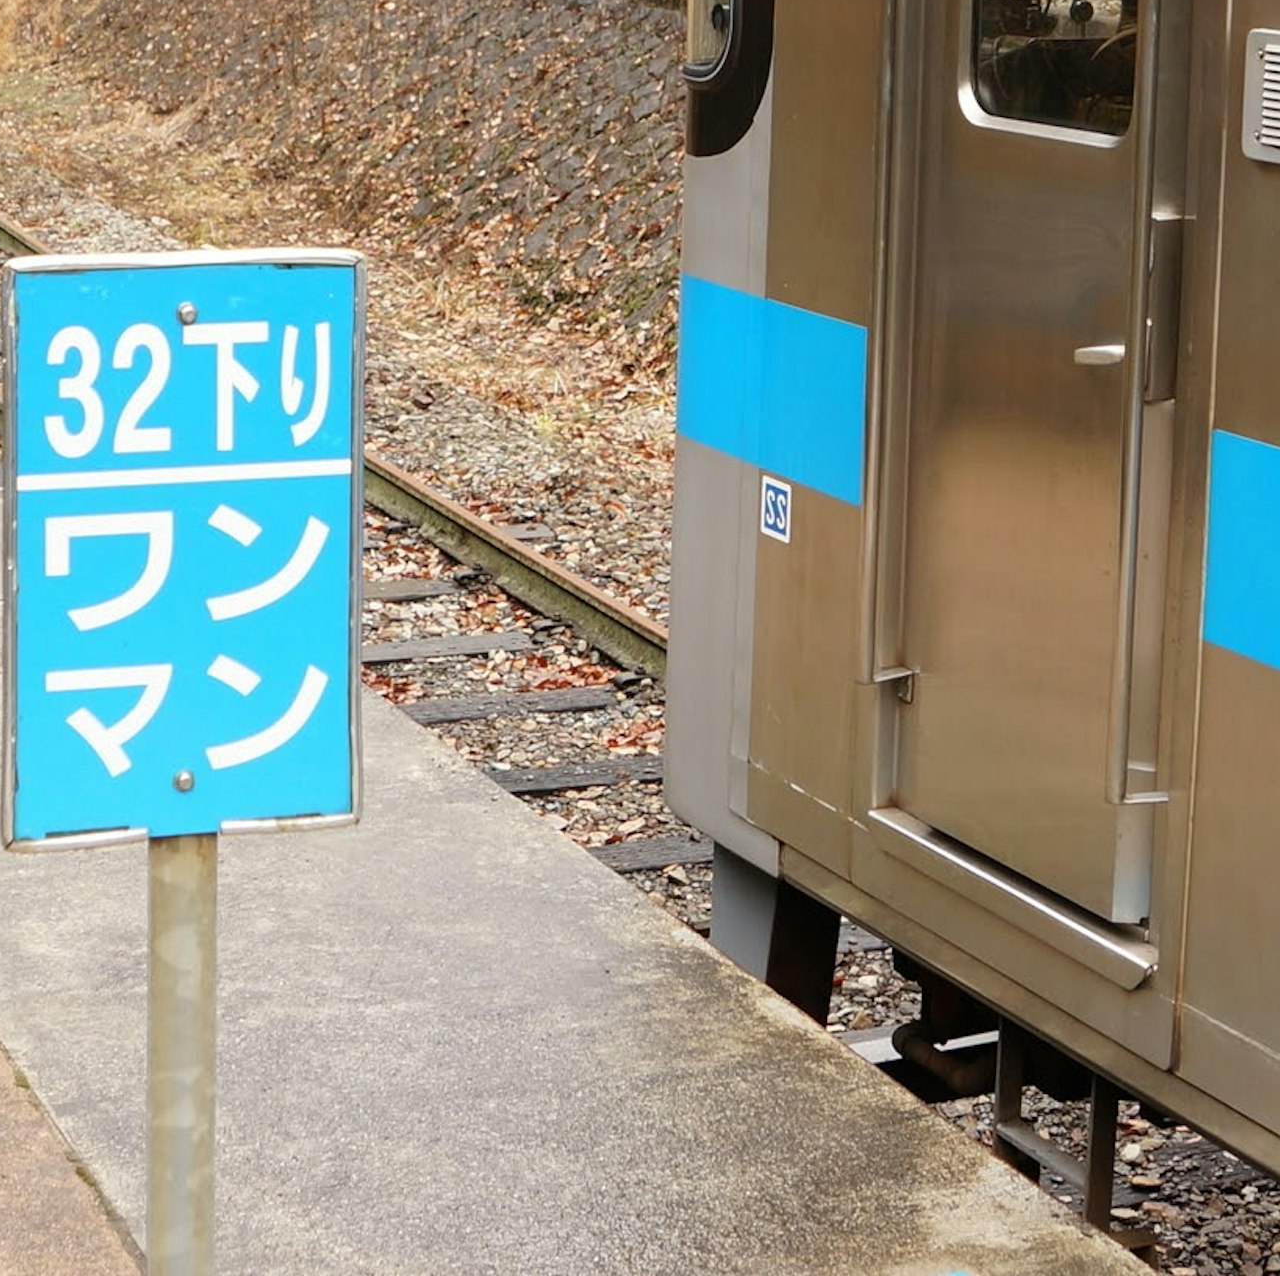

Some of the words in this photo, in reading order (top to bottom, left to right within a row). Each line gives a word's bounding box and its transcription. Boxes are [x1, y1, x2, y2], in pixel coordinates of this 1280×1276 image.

[43, 320, 332, 460] 32下り
[43, 504, 331, 632] ワン
[765, 489, 786, 530] SS
[44, 654, 330, 778] マン
